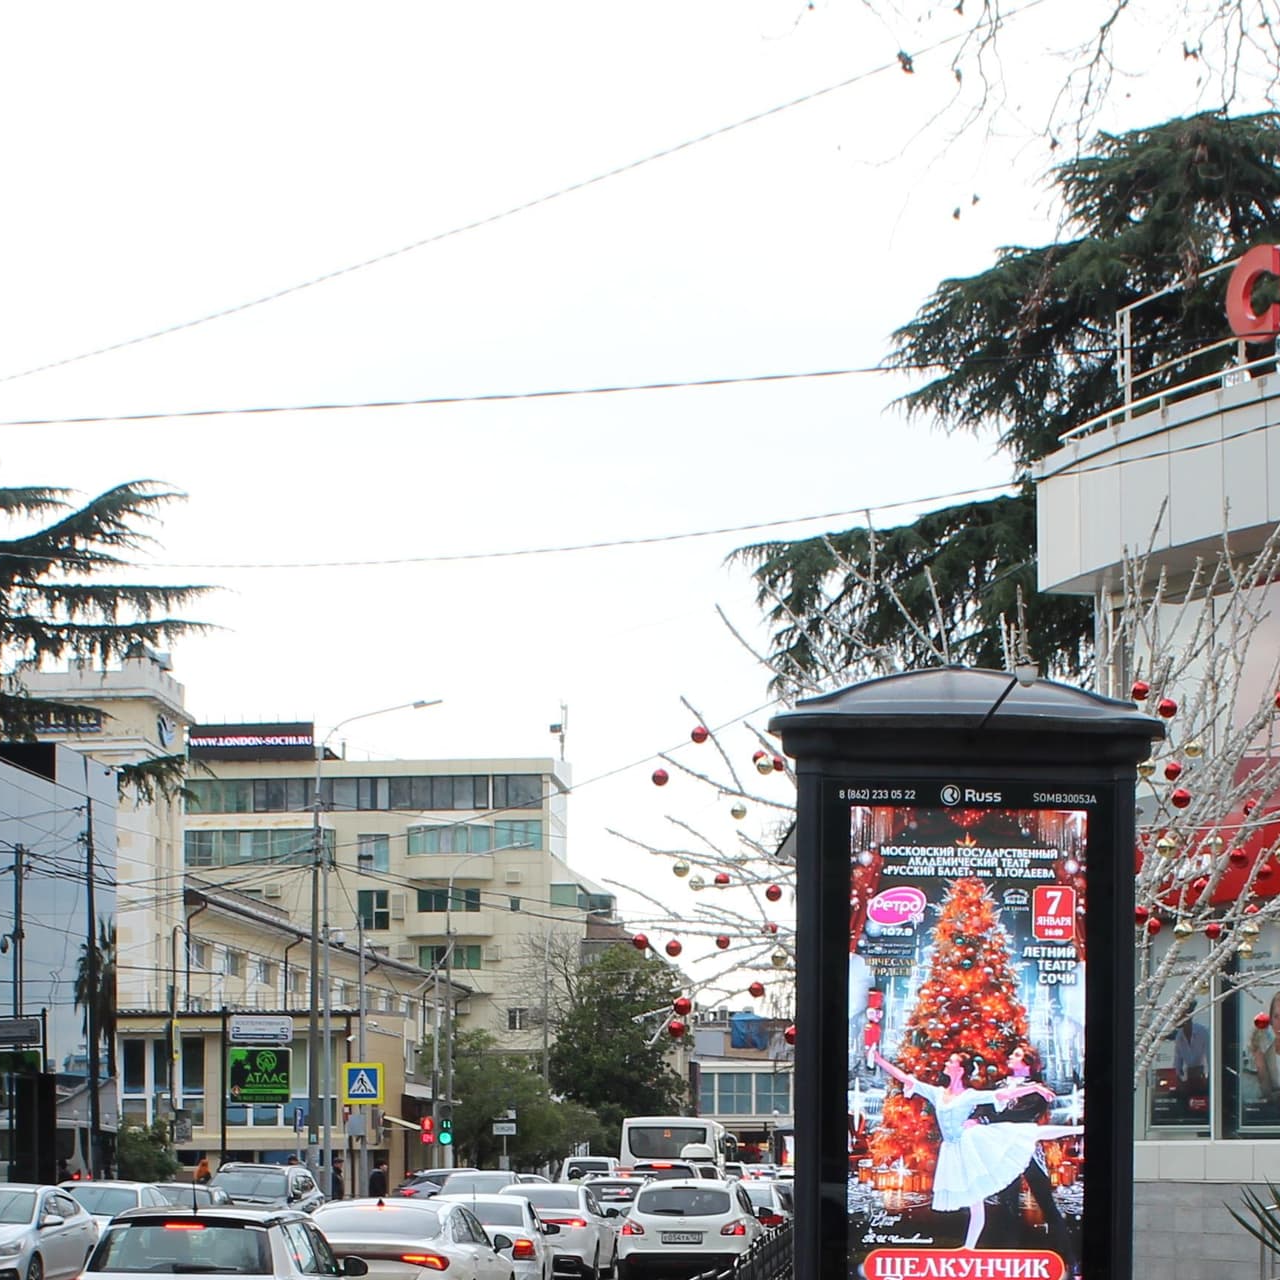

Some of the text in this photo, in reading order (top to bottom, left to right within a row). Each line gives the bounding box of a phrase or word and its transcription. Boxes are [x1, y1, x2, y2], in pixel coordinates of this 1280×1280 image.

[189, 735, 313, 747] WWW.LONDON-SOCHI.RU
[839, 789, 916, 800] 8 (862) 233 05 22
[964, 789, 1002, 802] Russ
[880, 846, 1058, 859] МОСКОВСКИЙ ГОСУДАРСТВЕННЫЙ
[908, 857, 1031, 868] АКАДЕМИЧЕСКИЙ ТЕАТР
[883, 865, 935, 875] «РУССКИЙ
[937, 867, 974, 876] БАЛЕТ»
[996, 868, 1056, 878] В.ГОРДЕЕВА
[873, 896, 921, 915] Ретро
[1046, 891, 1062, 915] 7
[1036, 916, 1072, 926] ЯНВАРЯ
[1023, 946, 1076, 957] ЛЕТНИЙ
[1037, 960, 1076, 971] ТЕАТР
[1039, 973, 1075, 984] СОЧИ
[246, 1072, 288, 1084] АТЛАС
[875, 1257, 1050, 1280] ЩЕЛКУНЧИК
